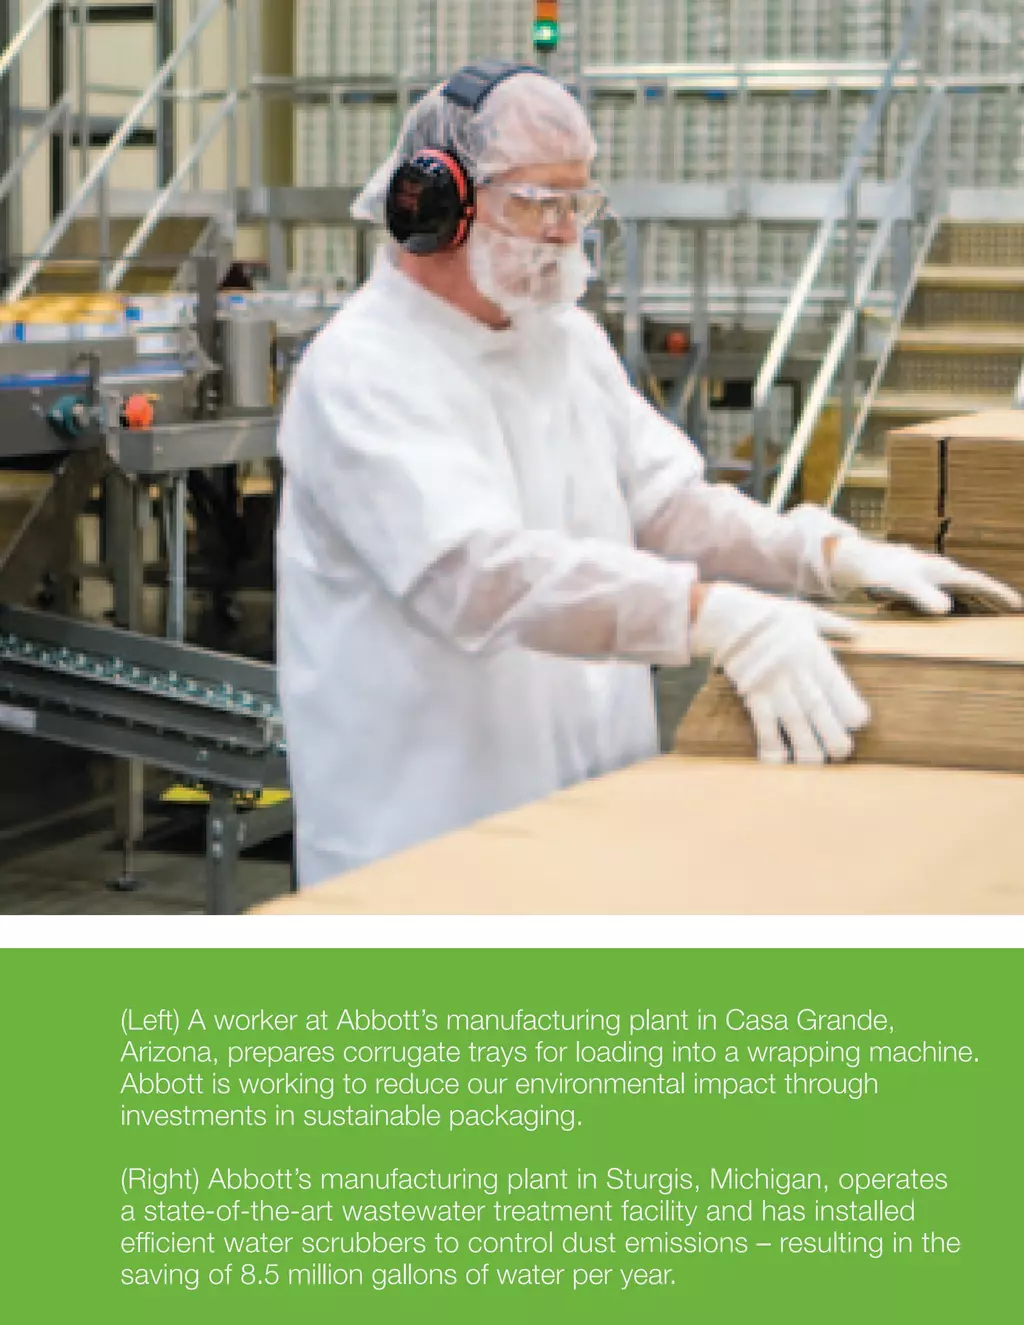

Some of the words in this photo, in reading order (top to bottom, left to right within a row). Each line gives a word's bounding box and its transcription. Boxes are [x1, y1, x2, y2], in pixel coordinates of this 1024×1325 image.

[121, 1008, 180, 1036] (Left)
[187, 1008, 207, 1031] A
[213, 1008, 298, 1031] worker
[305, 1009, 329, 1031] at
[446, 1008, 621, 1037] manufacturing
[629, 1008, 689, 1036] plant
[697, 1008, 717, 1031] in
[725, 1008, 789, 1031] Casa
[796, 1007, 894, 1034] Grande,
[121, 1104, 267, 1127] investments
[275, 1103, 295, 1126] in
[303, 1103, 441, 1127] sustainable
[449, 1103, 582, 1132] packaging.
[120, 1204, 136, 1222] a
[143, 1199, 333, 1222] state-of-the-art
[341, 1200, 486, 1222] wastewater
[493, 1200, 613, 1222] treatment
[620, 1199, 698, 1227] facility
[706, 1199, 753, 1222] and
[762, 1199, 806, 1222] has
[815, 1199, 915, 1222] installed
[120, 1263, 200, 1291] saving
[208, 1263, 233, 1286] of
[240, 1263, 280, 1286] 8.5
[288, 1262, 363, 1286] million
[371, 1262, 458, 1291] gallons
[465, 1263, 490, 1286] of
[496, 1264, 565, 1286] water
[573, 1267, 613, 1291] per
[619, 1267, 675, 1291] year.
